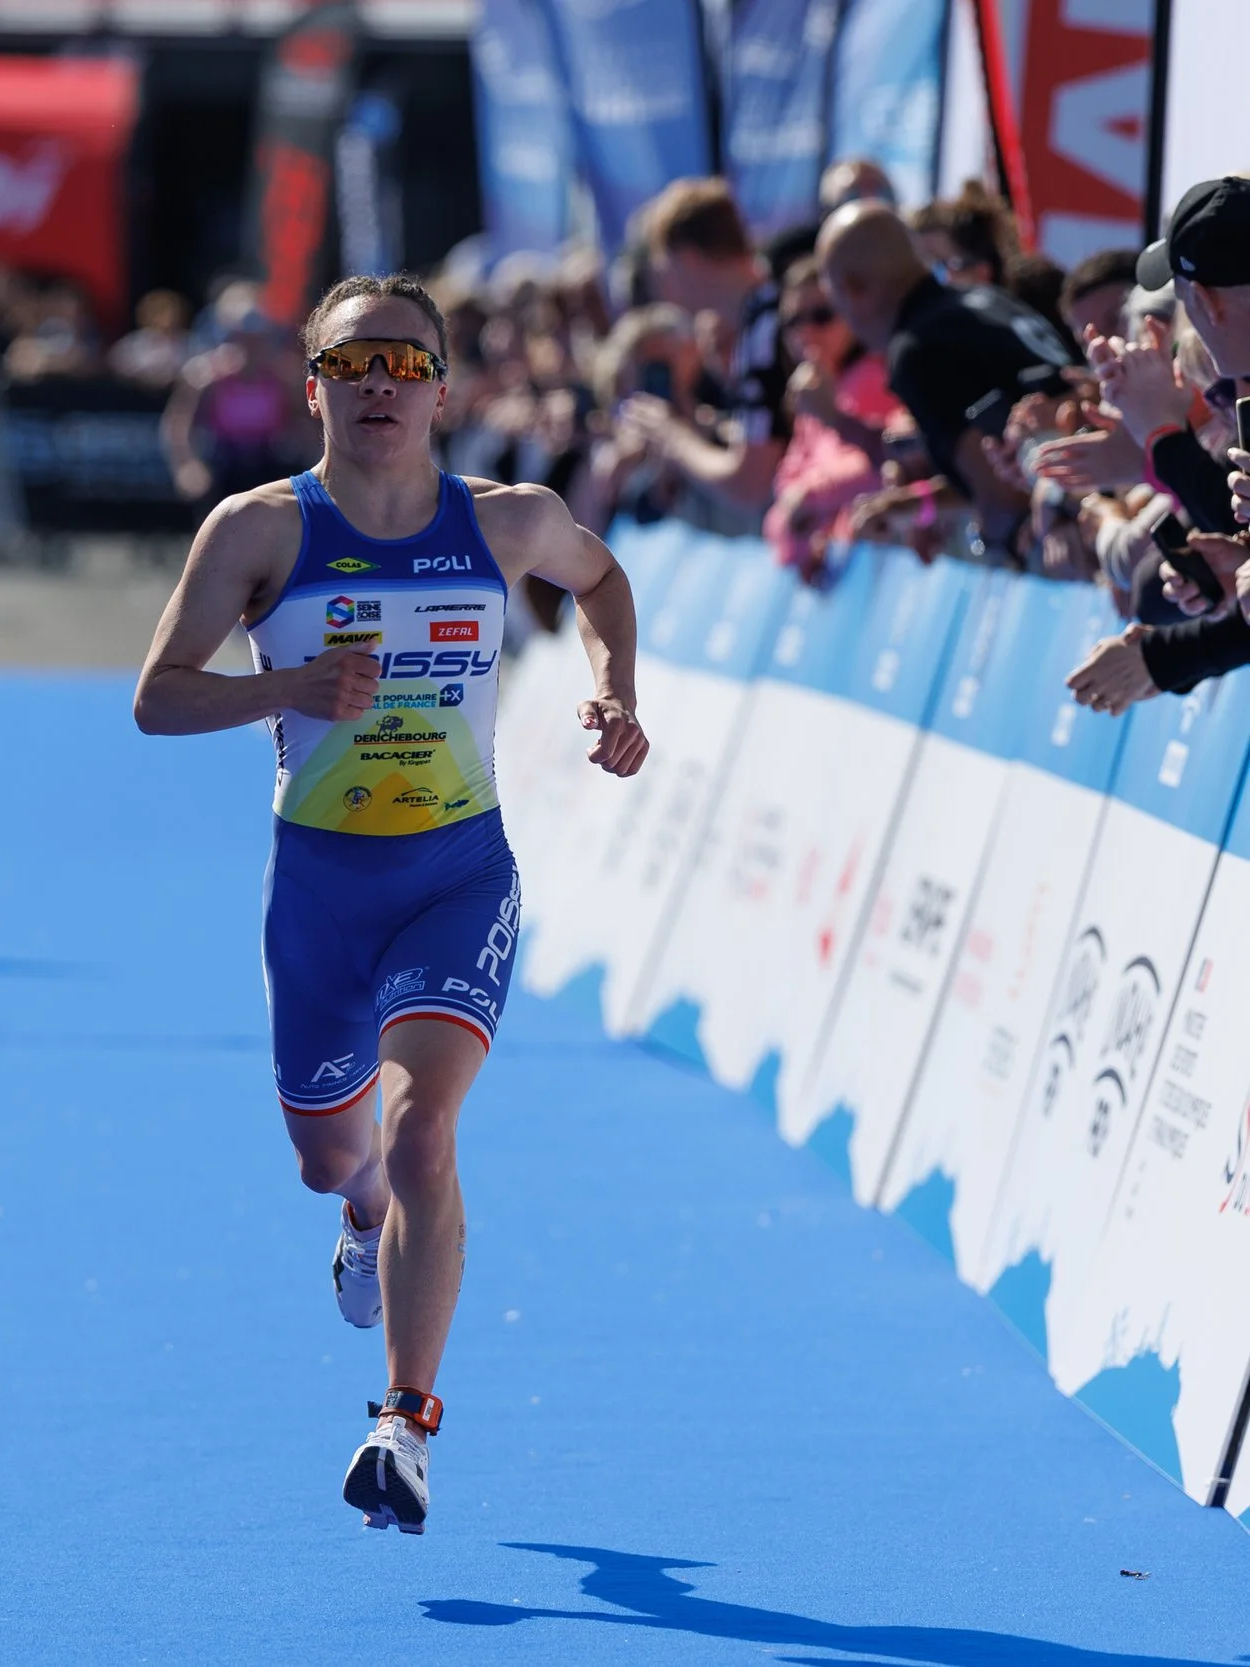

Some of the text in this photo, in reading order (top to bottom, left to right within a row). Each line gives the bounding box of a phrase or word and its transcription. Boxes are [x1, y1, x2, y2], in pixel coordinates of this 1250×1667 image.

[335, 561, 362, 569] COLAS
[413, 555, 472, 574] POLI
[414, 603, 487, 613] LAPIERRE
[438, 627, 474, 637] ZEFAL
[383, 693, 437, 703] POPULAIRE
[398, 701, 437, 709] FRANCE
[354, 732, 447, 743] DERICHEBOURG
[360, 750, 433, 761] BACACIER
[392, 795, 440, 804] ARTELIA
